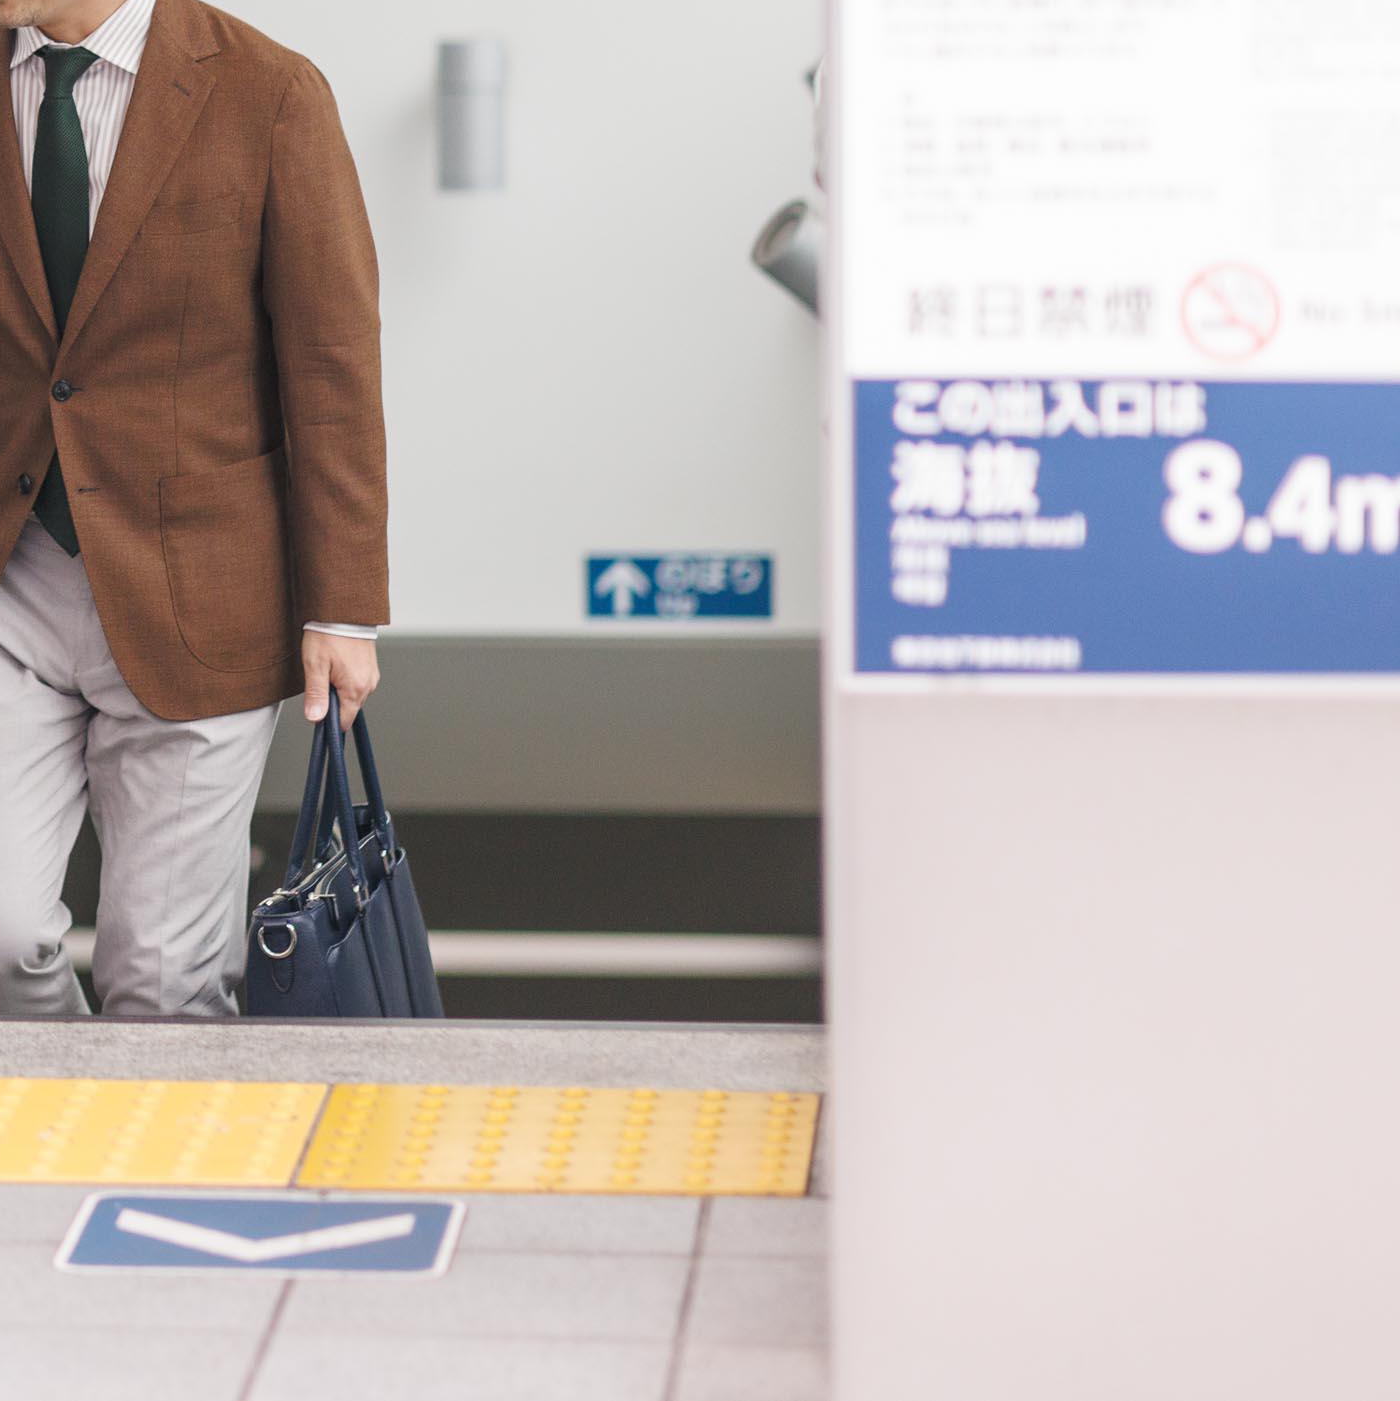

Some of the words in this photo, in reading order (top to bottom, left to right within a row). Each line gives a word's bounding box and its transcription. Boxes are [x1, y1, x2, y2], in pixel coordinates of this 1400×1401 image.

[892, 381, 1207, 438] この出入口は
[1161, 437, 1400, 555] 8.4m
[654, 556, 764, 595] のぼり
